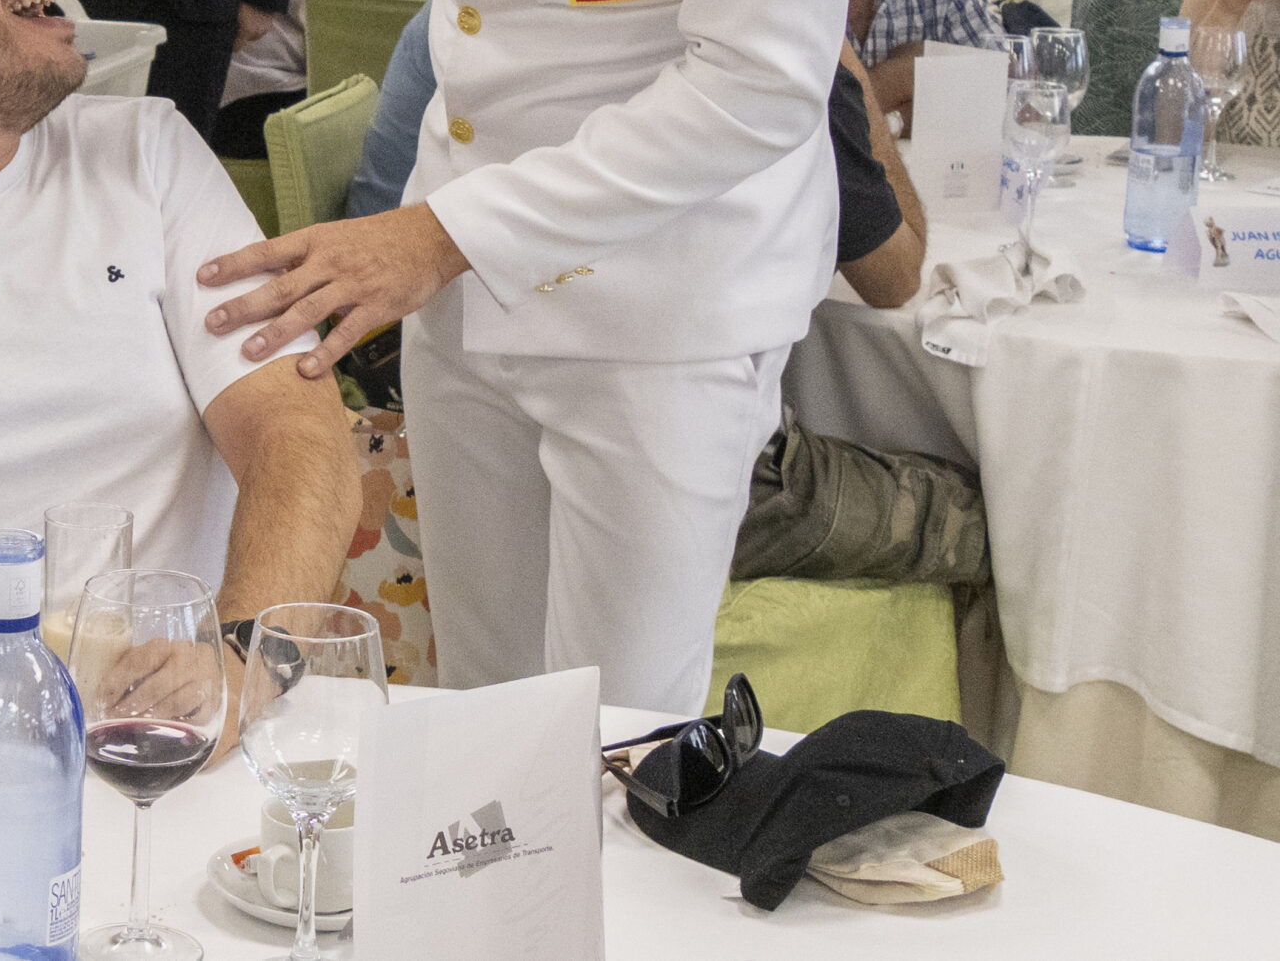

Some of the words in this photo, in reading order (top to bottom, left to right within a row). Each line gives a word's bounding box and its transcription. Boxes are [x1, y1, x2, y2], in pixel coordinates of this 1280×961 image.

[1231, 230, 1269, 242] JUAN
[107, 265, 125, 283] &
[426, 826, 516, 860] Asetra
